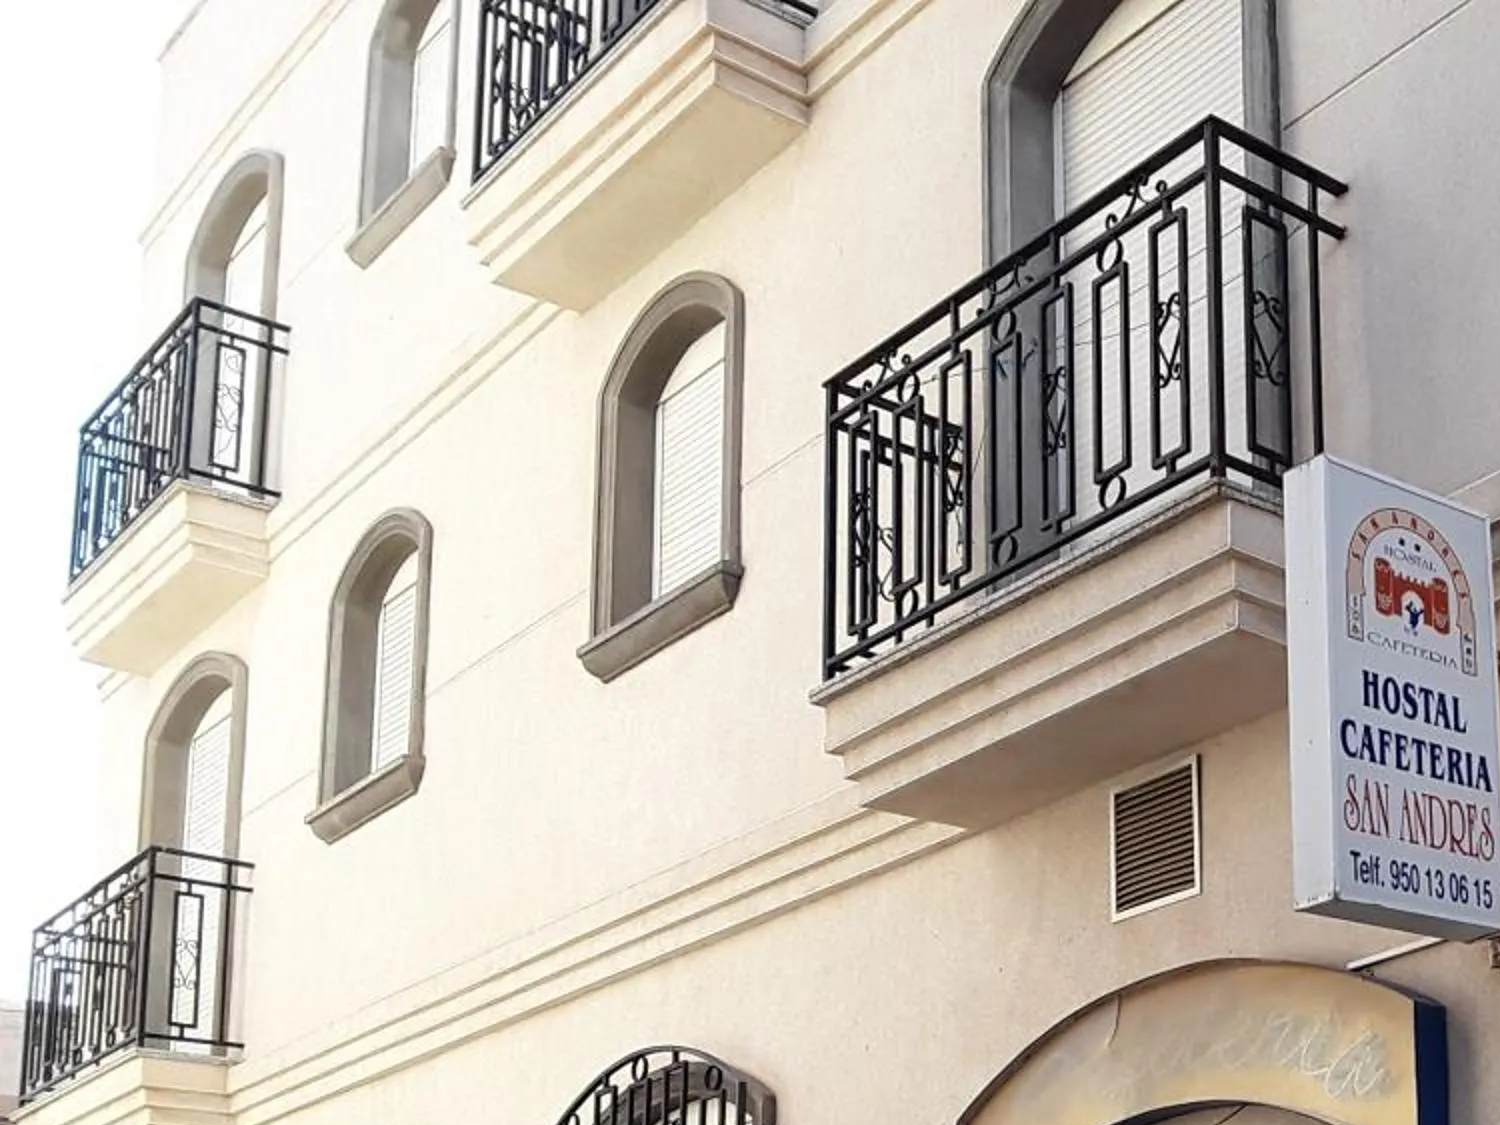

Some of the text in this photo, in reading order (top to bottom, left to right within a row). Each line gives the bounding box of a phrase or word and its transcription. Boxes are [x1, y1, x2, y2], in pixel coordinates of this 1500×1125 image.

[1383, 544, 1437, 574] HOSTAL
[1362, 669, 1468, 734] HOSTAL
[1340, 718, 1493, 793] CAFETERIA
[1344, 773, 1495, 862] SAN ANDRES
[1350, 850, 1493, 909] Telf. 950 13 06 15
